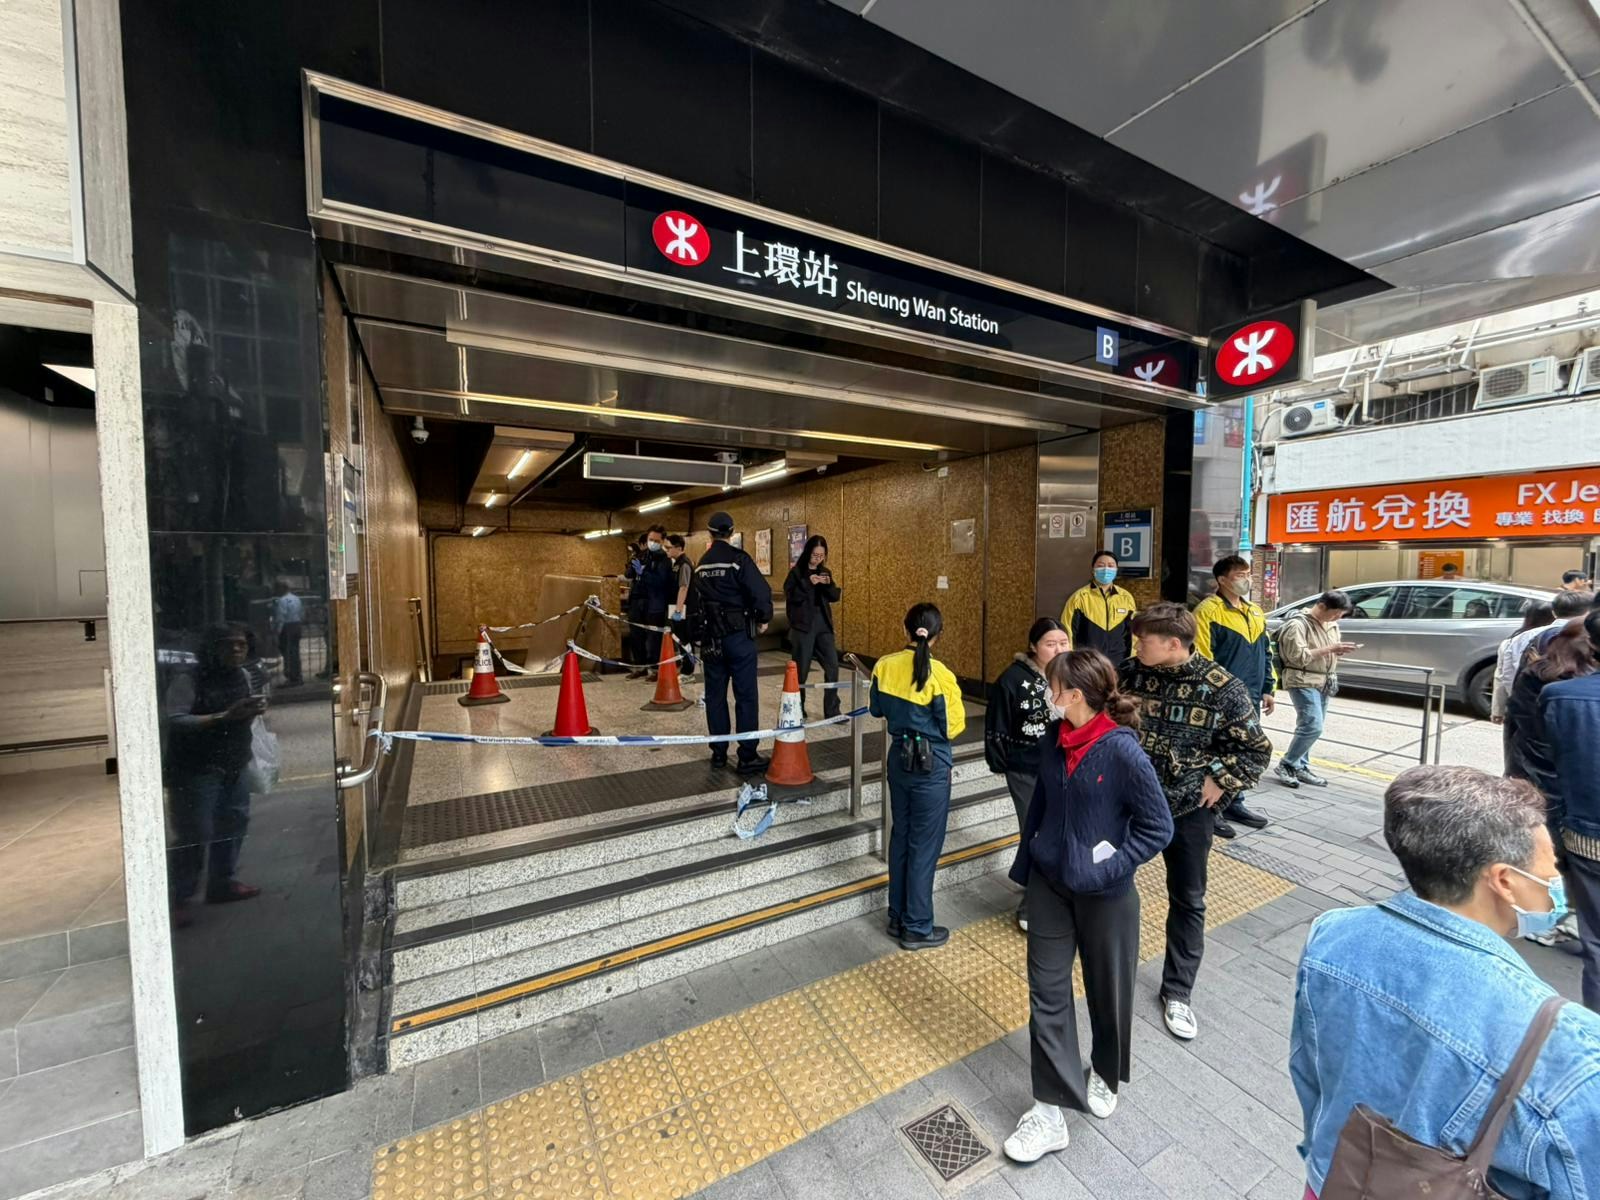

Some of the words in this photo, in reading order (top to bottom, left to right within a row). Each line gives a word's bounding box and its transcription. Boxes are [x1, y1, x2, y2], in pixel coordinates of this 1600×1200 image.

[722, 230, 838, 298] 上環站
[846, 281, 909, 317] Sheung
[912, 296, 946, 323] Wan
[949, 307, 999, 334] Station
[1102, 334, 1114, 359] B
[1517, 481, 1558, 506] FX
[1562, 479, 1600, 504] Je
[1542, 509, 1585, 525] 找換
[1120, 537, 1134, 557] B
